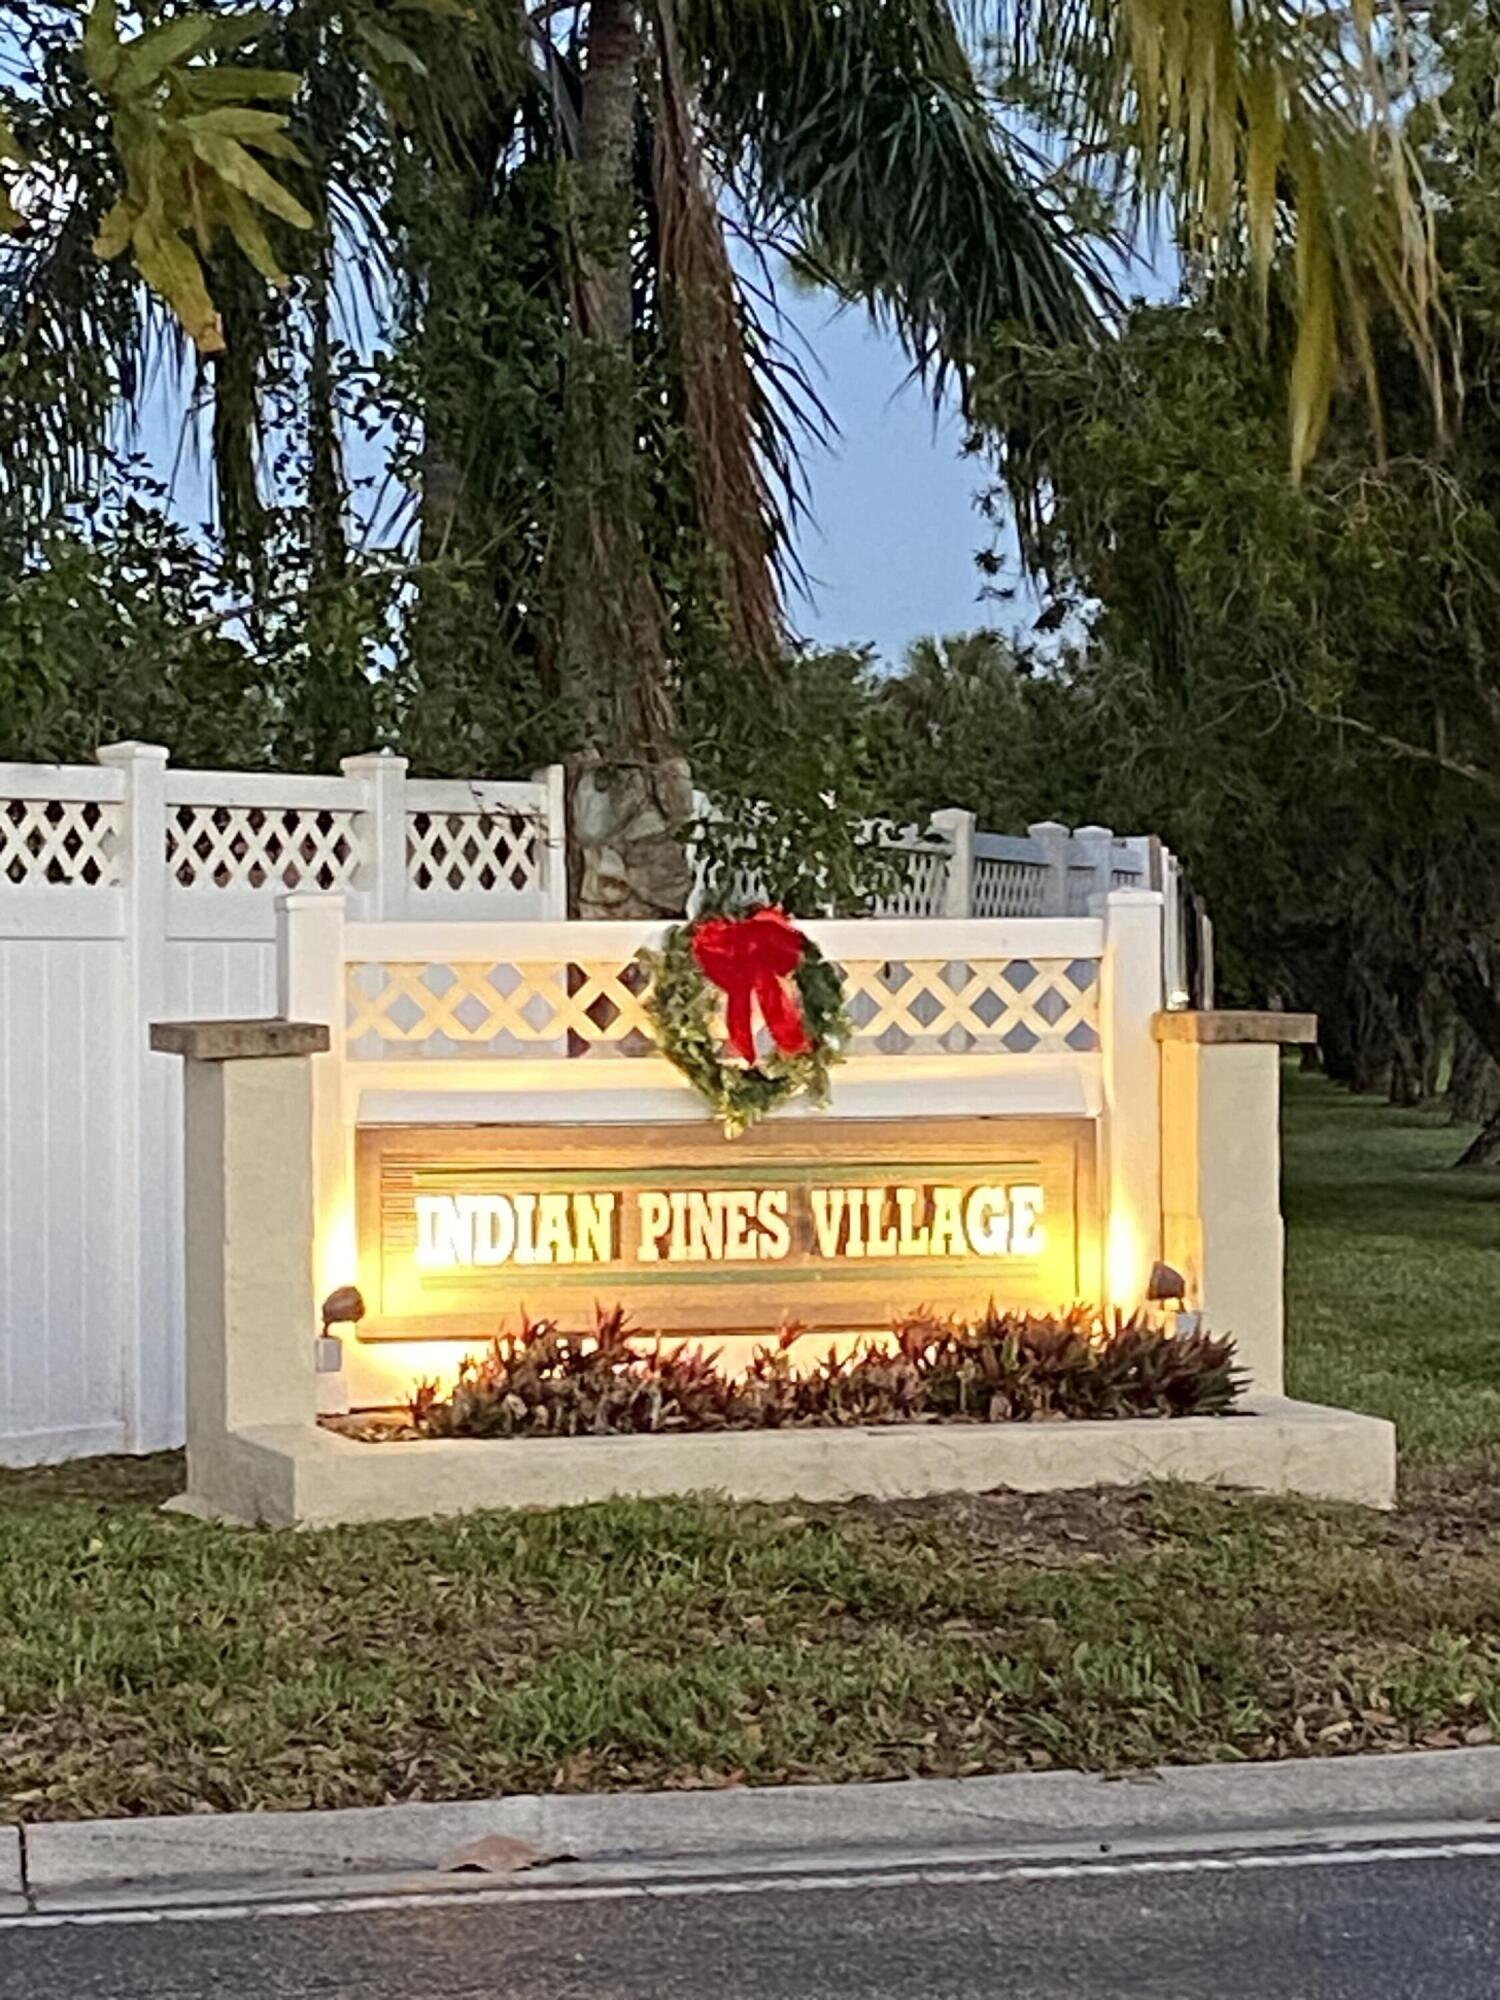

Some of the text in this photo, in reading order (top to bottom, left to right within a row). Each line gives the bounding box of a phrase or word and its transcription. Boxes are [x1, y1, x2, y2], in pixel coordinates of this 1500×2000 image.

[414, 1185, 1046, 1266] INDIAN PINES VILLAGE
